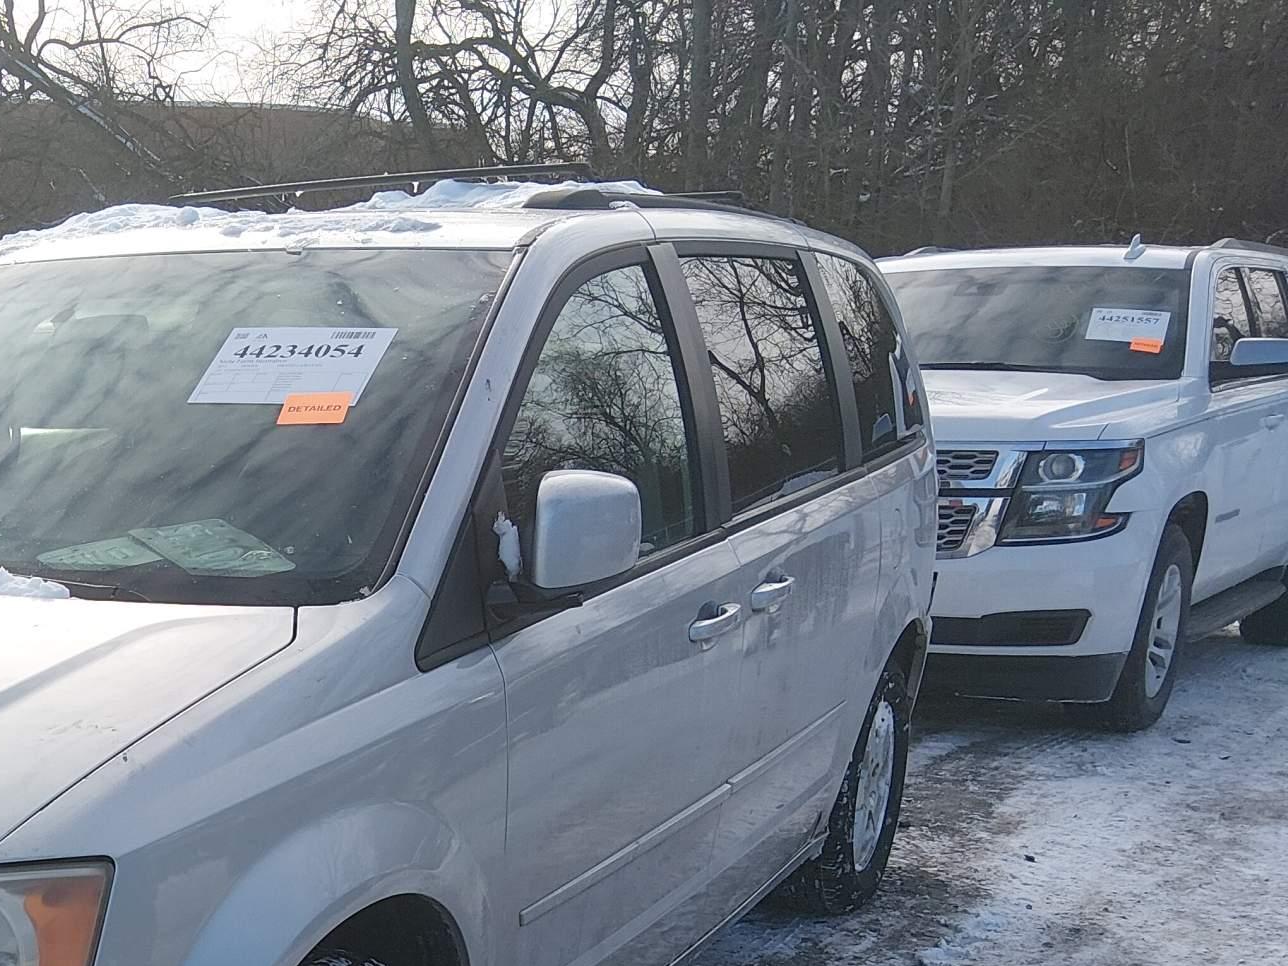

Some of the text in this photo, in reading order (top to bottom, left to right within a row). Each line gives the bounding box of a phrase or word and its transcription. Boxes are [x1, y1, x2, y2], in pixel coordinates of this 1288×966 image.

[1098, 315, 1160, 326] 44251557
[233, 343, 364, 358] 44234054
[287, 405, 342, 413] DETAILED
